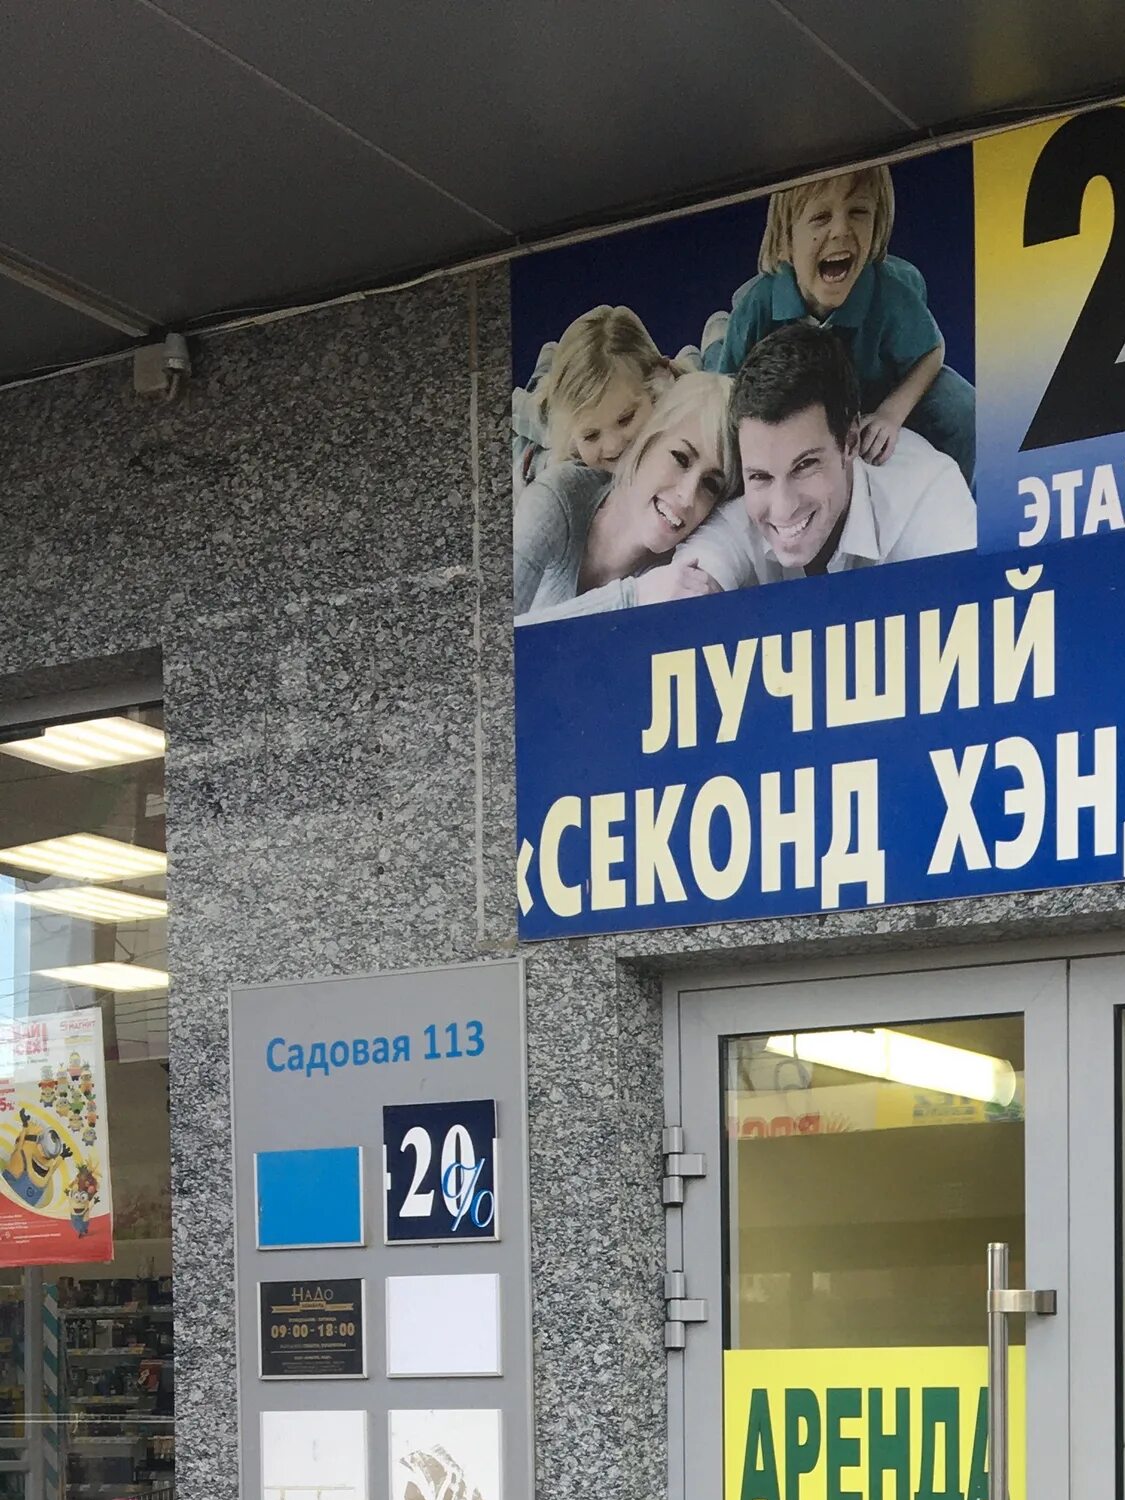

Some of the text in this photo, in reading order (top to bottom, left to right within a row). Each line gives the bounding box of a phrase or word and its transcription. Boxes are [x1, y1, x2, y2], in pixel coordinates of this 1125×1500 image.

[641, 564, 1055, 755] ЛУЧШИЙ
[266, 1020, 486, 1078] Садовая 113
